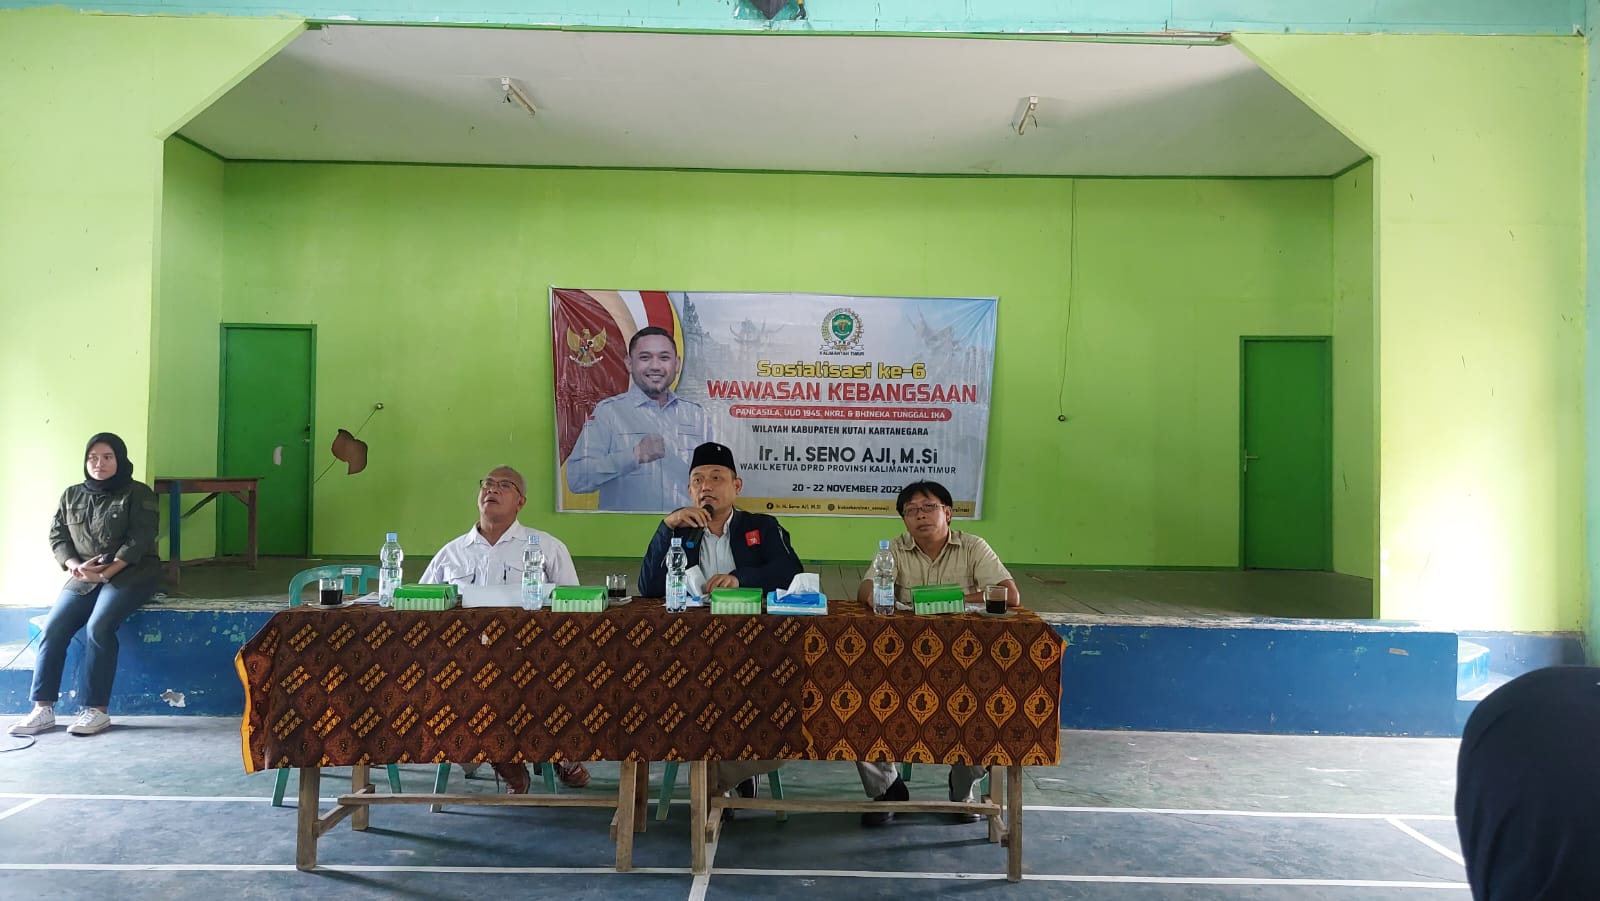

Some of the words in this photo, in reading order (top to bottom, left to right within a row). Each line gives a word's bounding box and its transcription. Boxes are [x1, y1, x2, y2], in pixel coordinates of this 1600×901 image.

[757, 359, 873, 379] Sosialisasi
[877, 362, 926, 380] ke-6
[706, 379, 821, 402] WAWASAN
[827, 382, 977, 403] KEBANGSAAN
[735, 408, 782, 417] PANCASILA,
[783, 409, 801, 417] UUD
[847, 410, 854, 418] &
[855, 410, 890, 418] BHINEKA
[893, 411, 929, 419] TUNGGAL
[931, 411, 946, 419] IKA
[751, 424, 789, 434] WILAYAH
[791, 425, 840, 435] KABUPATEN
[842, 426, 867, 436] KUTAI
[868, 427, 929, 436] KARTANEGARA
[758, 445, 779, 462] Ir.
[784, 445, 801, 462] H.
[805, 446, 856, 463] SENO
[862, 447, 897, 466] AJI,
[900, 448, 938, 465] M.Si
[740, 463, 768, 472] WAKIL
[769, 463, 799, 472] KETUA
[800, 464, 825, 473] DPRD
[827, 465, 867, 473] PROVINSI
[869, 466, 926, 474] KALIMANTAN
[928, 467, 957, 475] TIMUR
[792, 483, 804, 493] 20
[812, 484, 825, 493] 22
[826, 484, 878, 494] NOVEMBER
[880, 485, 903, 494] 2023
